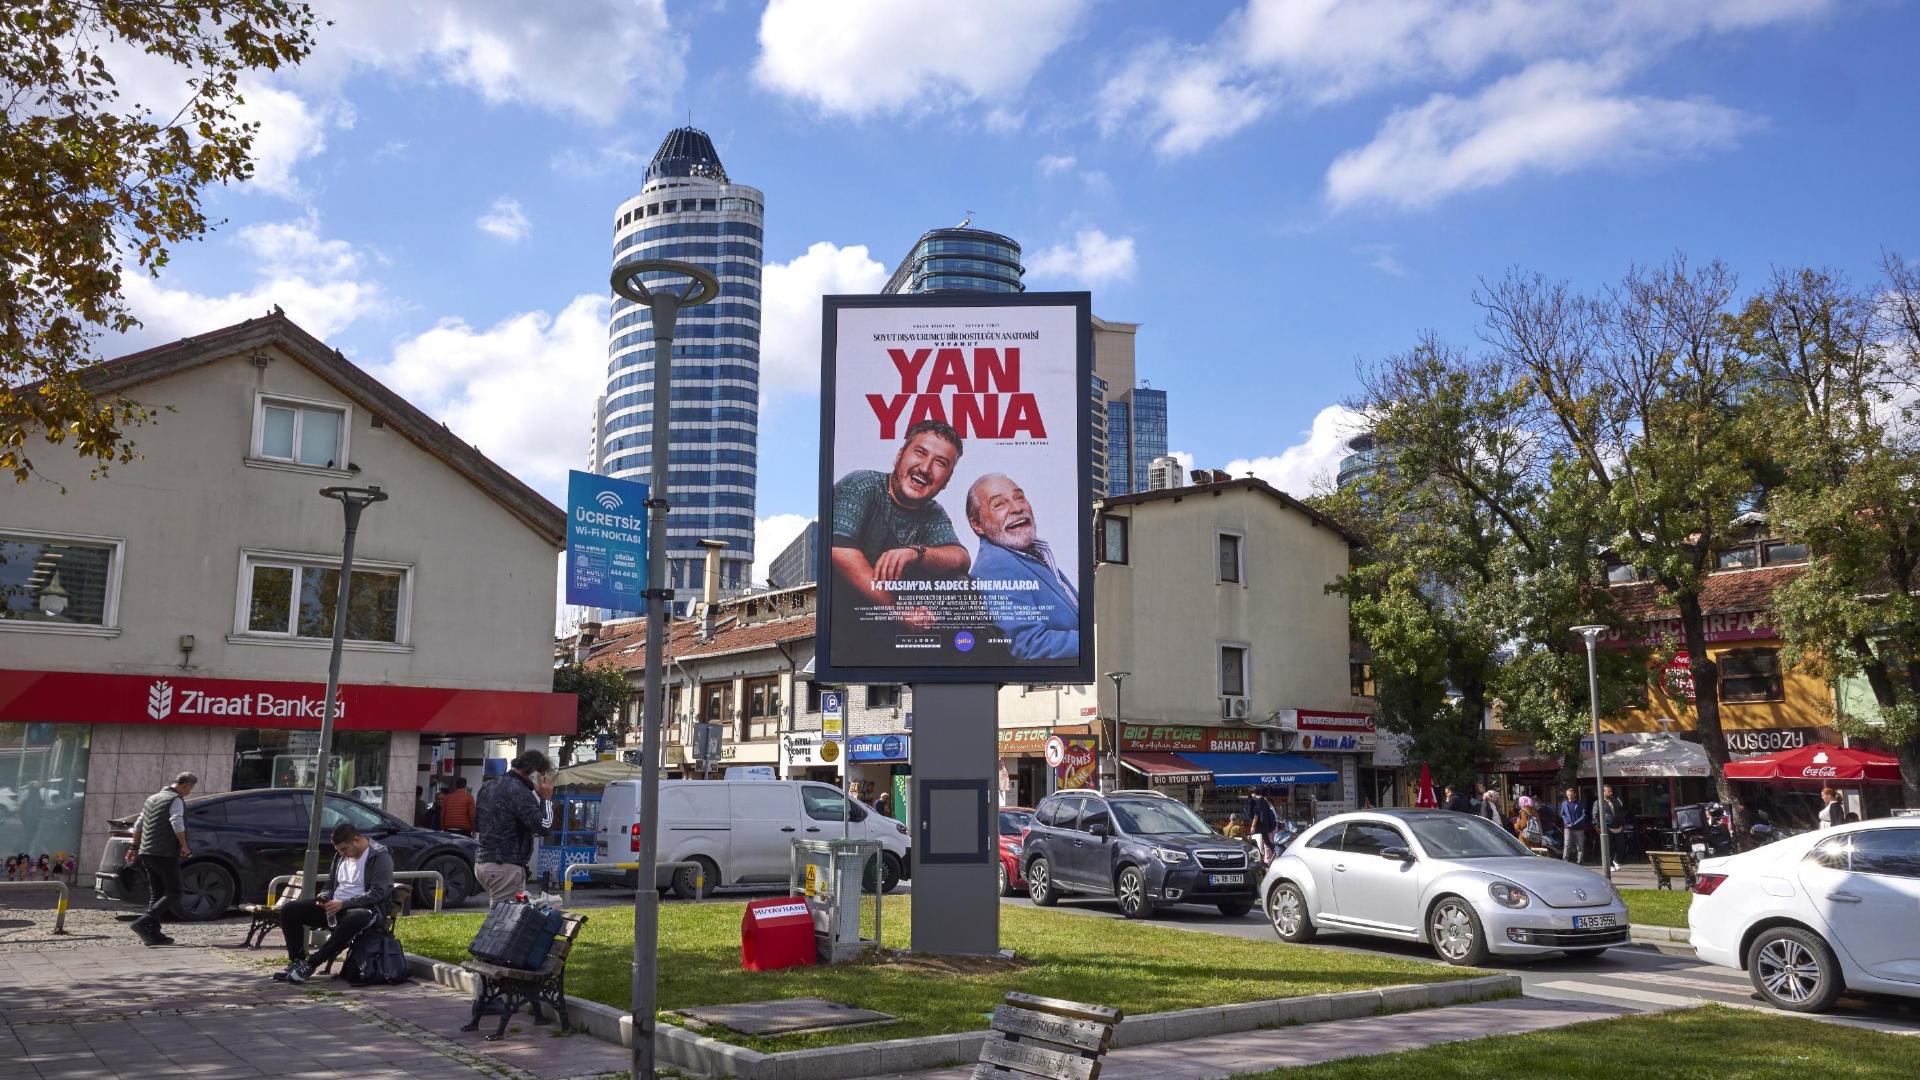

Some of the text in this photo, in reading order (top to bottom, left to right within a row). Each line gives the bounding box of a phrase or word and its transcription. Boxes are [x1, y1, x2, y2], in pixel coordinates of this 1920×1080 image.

[873, 333, 897, 341] SOYUT
[946, 331, 959, 341] BİR
[1001, 330, 1039, 340] ANATOMİSİ
[886, 347, 1021, 394] YAN
[865, 393, 1048, 440] YANA
[576, 506, 641, 530] ÜCRETSİZ
[575, 525, 641, 544] Wi-Fi NOKTASI
[870, 577, 1040, 591] 14 KASIM'DA SADECE SİNEMALARDA
[178, 690, 254, 716] Ziraat
[1123, 727, 1203, 740] BIO STORE
[854, 743, 873, 752] LEVENT
[1210, 740, 1256, 752] BAHARAT
[1313, 735, 1357, 749] Kam Air
[1802, 765, 1837, 777] Coca-Cola
[1168, 775, 1189, 784] STORE
[1579, 916, 1588, 928] 34
[1589, 916, 1599, 927] BS
